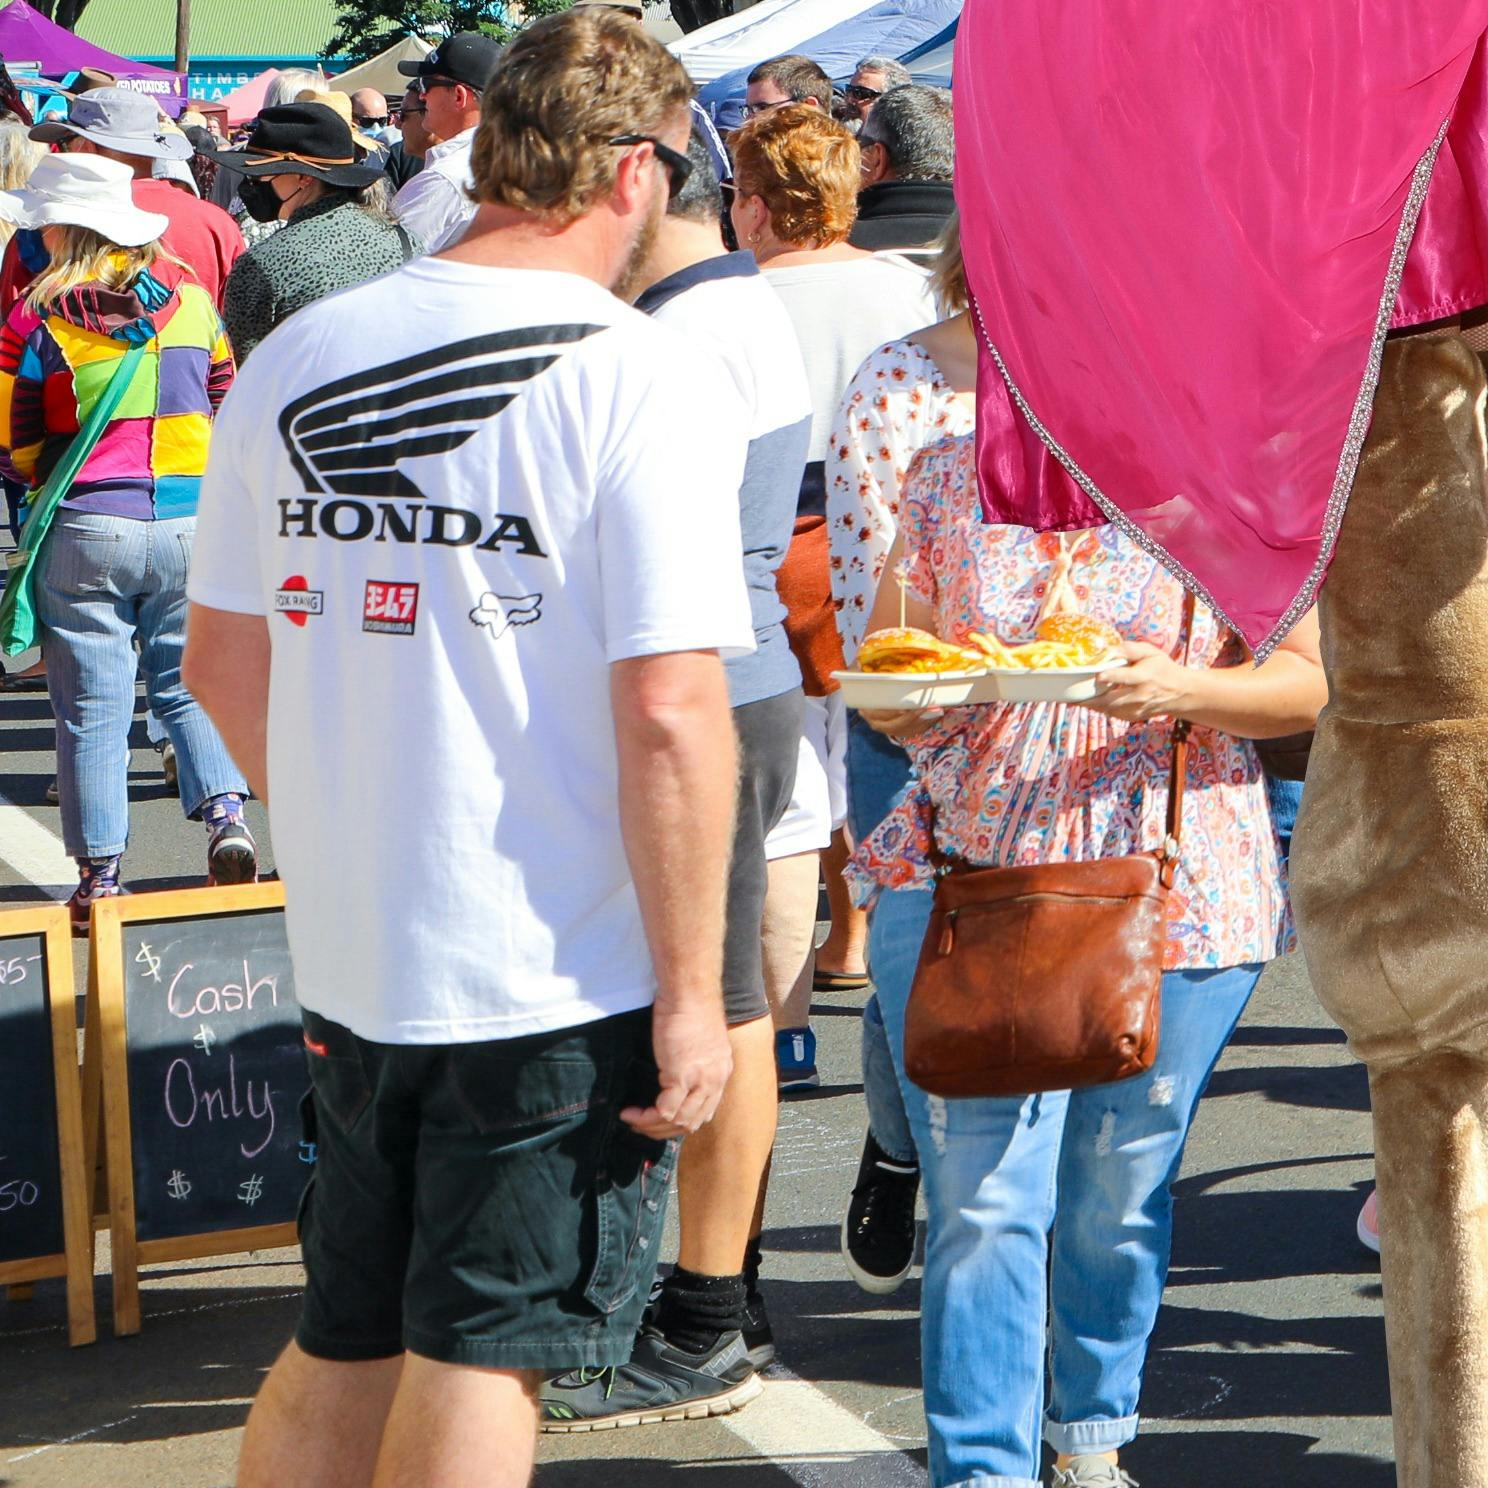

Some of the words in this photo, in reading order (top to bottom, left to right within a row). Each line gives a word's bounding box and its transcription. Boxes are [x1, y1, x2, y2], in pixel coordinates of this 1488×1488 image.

[131, 79, 171, 94] POTATOES
[278, 499, 548, 558] HONDA
[167, 959, 278, 1019] Cash
[165, 1054, 275, 1158] Only
